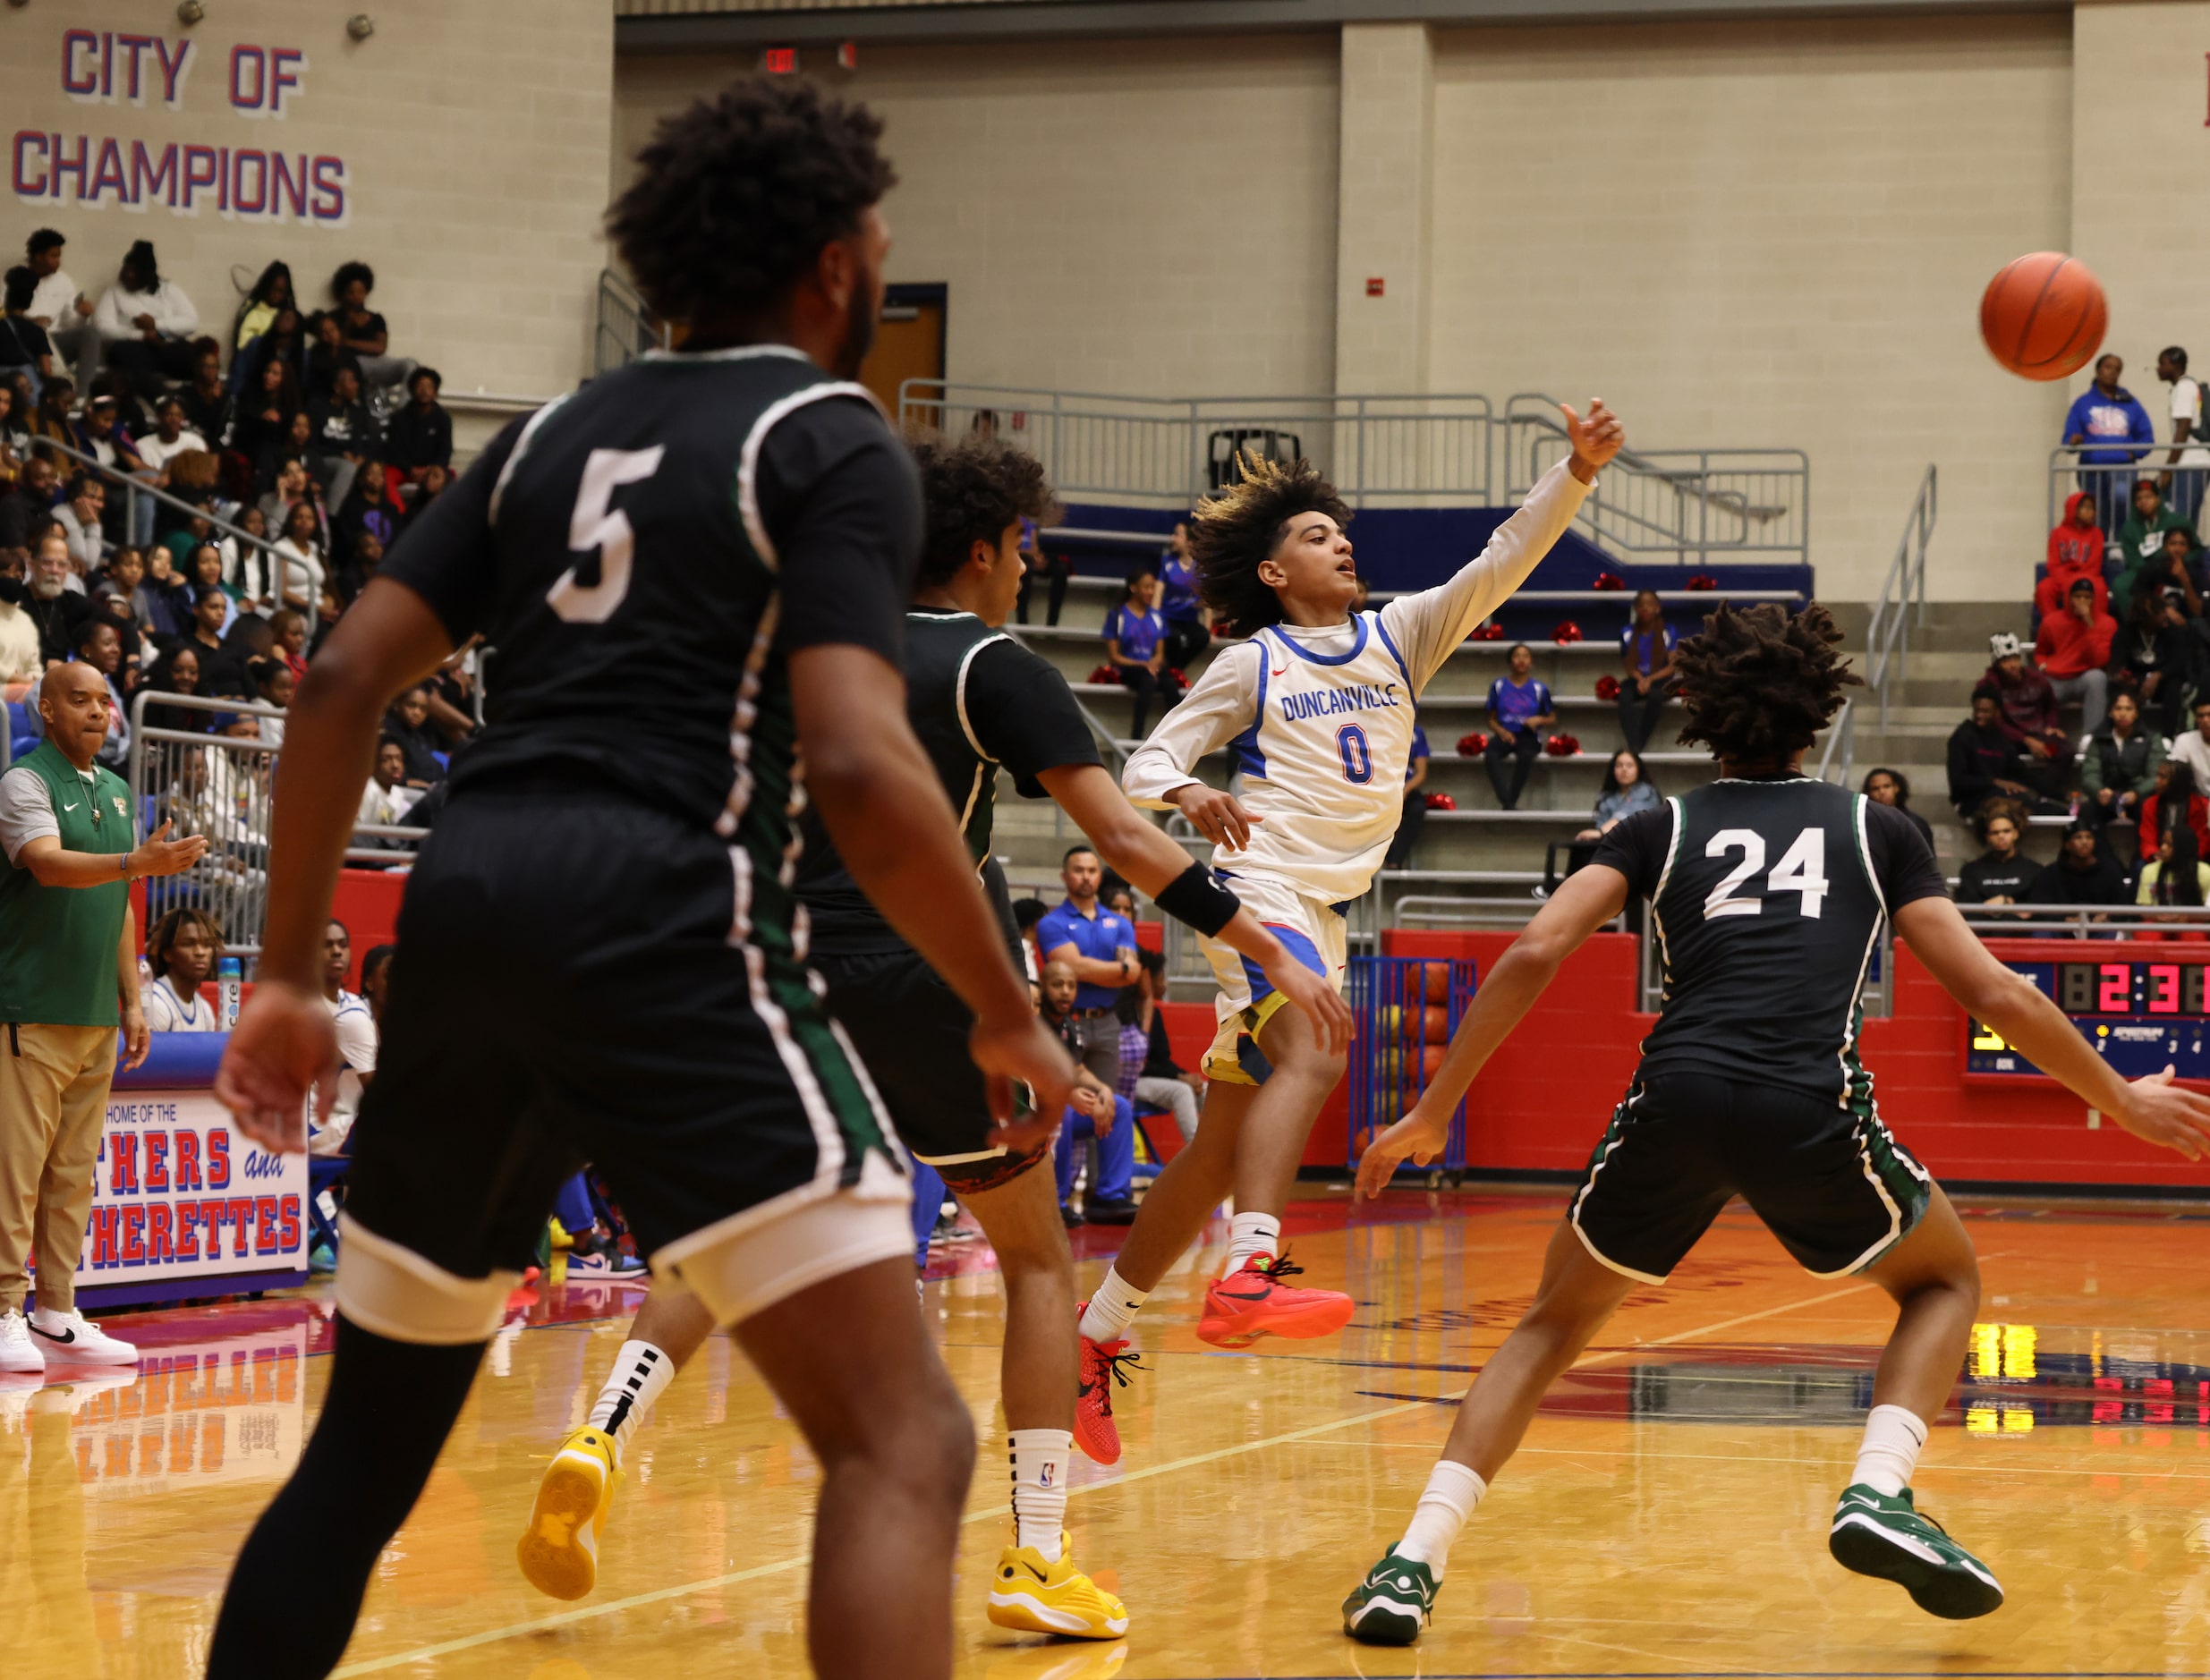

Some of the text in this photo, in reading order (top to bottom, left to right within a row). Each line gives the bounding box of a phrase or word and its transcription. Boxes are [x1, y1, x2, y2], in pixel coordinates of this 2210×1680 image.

[62, 28, 306, 115] CITY OF
[12, 129, 347, 224] CHAMPIONS
[545, 444, 667, 625] 5
[1280, 683, 1398, 722] DUNCANVILLE
[1334, 722, 1374, 785] 0
[1703, 827, 1829, 921] 24
[2095, 1038, 2107, 1053] 2
[2167, 1039, 2179, 1054] 3
[2191, 1039, 2201, 1054] 4
[106, 1103, 177, 1124] HOME OF THE
[84, 1192, 301, 1271] HERETTES
